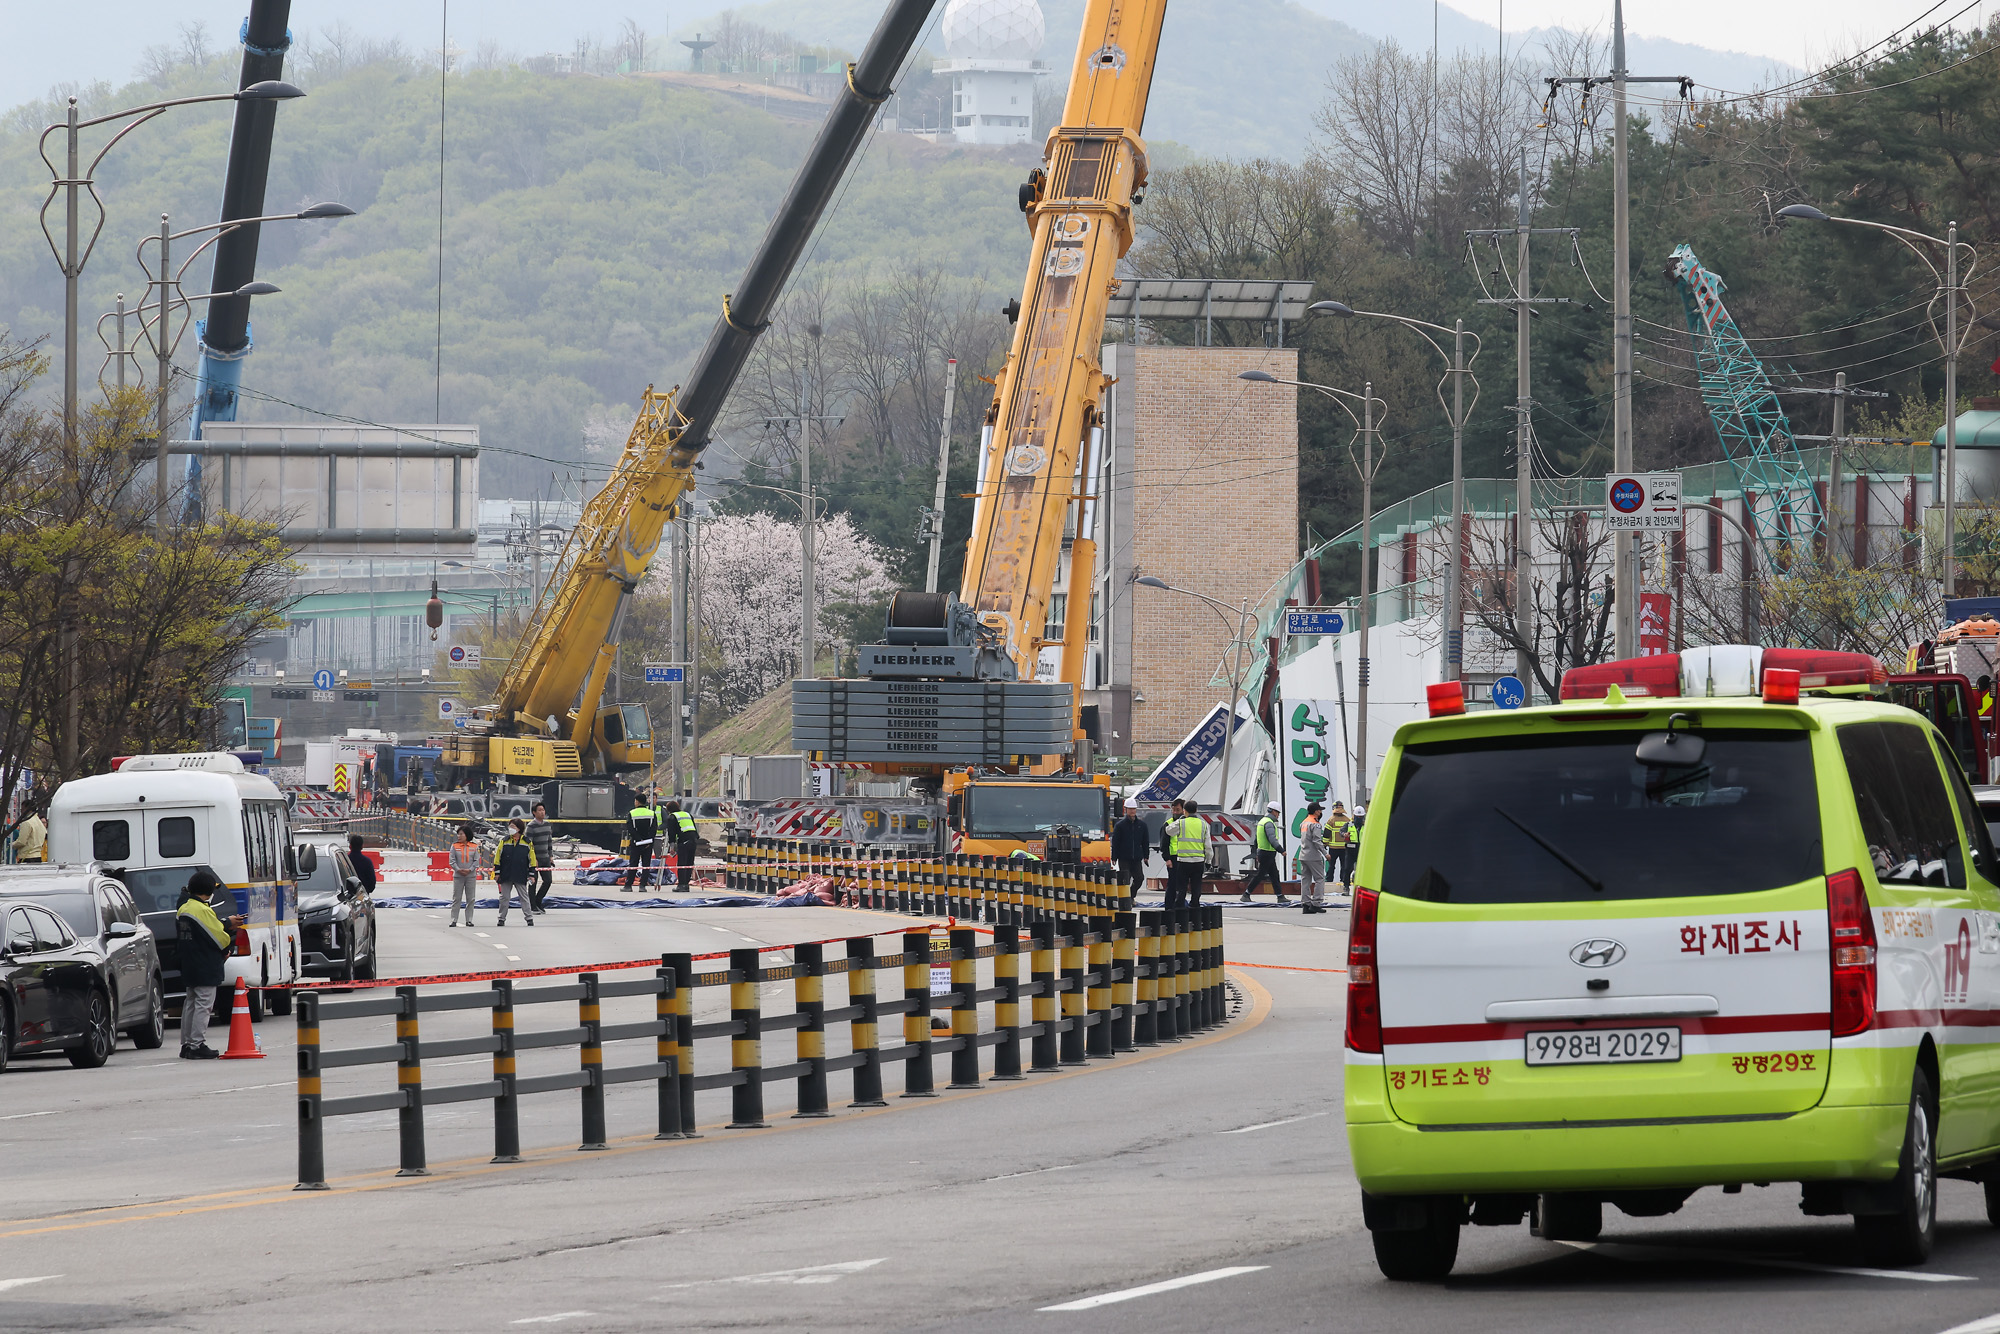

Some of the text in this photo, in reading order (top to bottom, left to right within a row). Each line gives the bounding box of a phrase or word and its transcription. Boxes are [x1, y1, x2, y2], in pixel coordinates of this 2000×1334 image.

[1609, 516, 1680, 527] 주정차금지 및 견인지역
[1290, 614, 1320, 626] 양달로
[1289, 625, 1324, 634] Yangdal-ro
[873, 654, 956, 666] LIEBHERR
[647, 668, 669, 676] 오리로
[887, 683, 939, 692] LIEBHERR
[887, 696, 939, 704] LIEBHERR
[887, 707, 939, 716] LIEBHERR
[887, 719, 939, 728] LIEBHERR
[887, 731, 939, 740] LIEBHERR
[887, 743, 939, 751] LIEBHERR
[1166, 711, 1236, 785] KCC 창호
[1680, 920, 1802, 956] 화재조사
[1944, 916, 1971, 1003] 119
[1536, 1031, 1671, 1060] 998러 2029
[1731, 1053, 1817, 1074] 광명29호
[1390, 1066, 1492, 1090] 경기도소방
